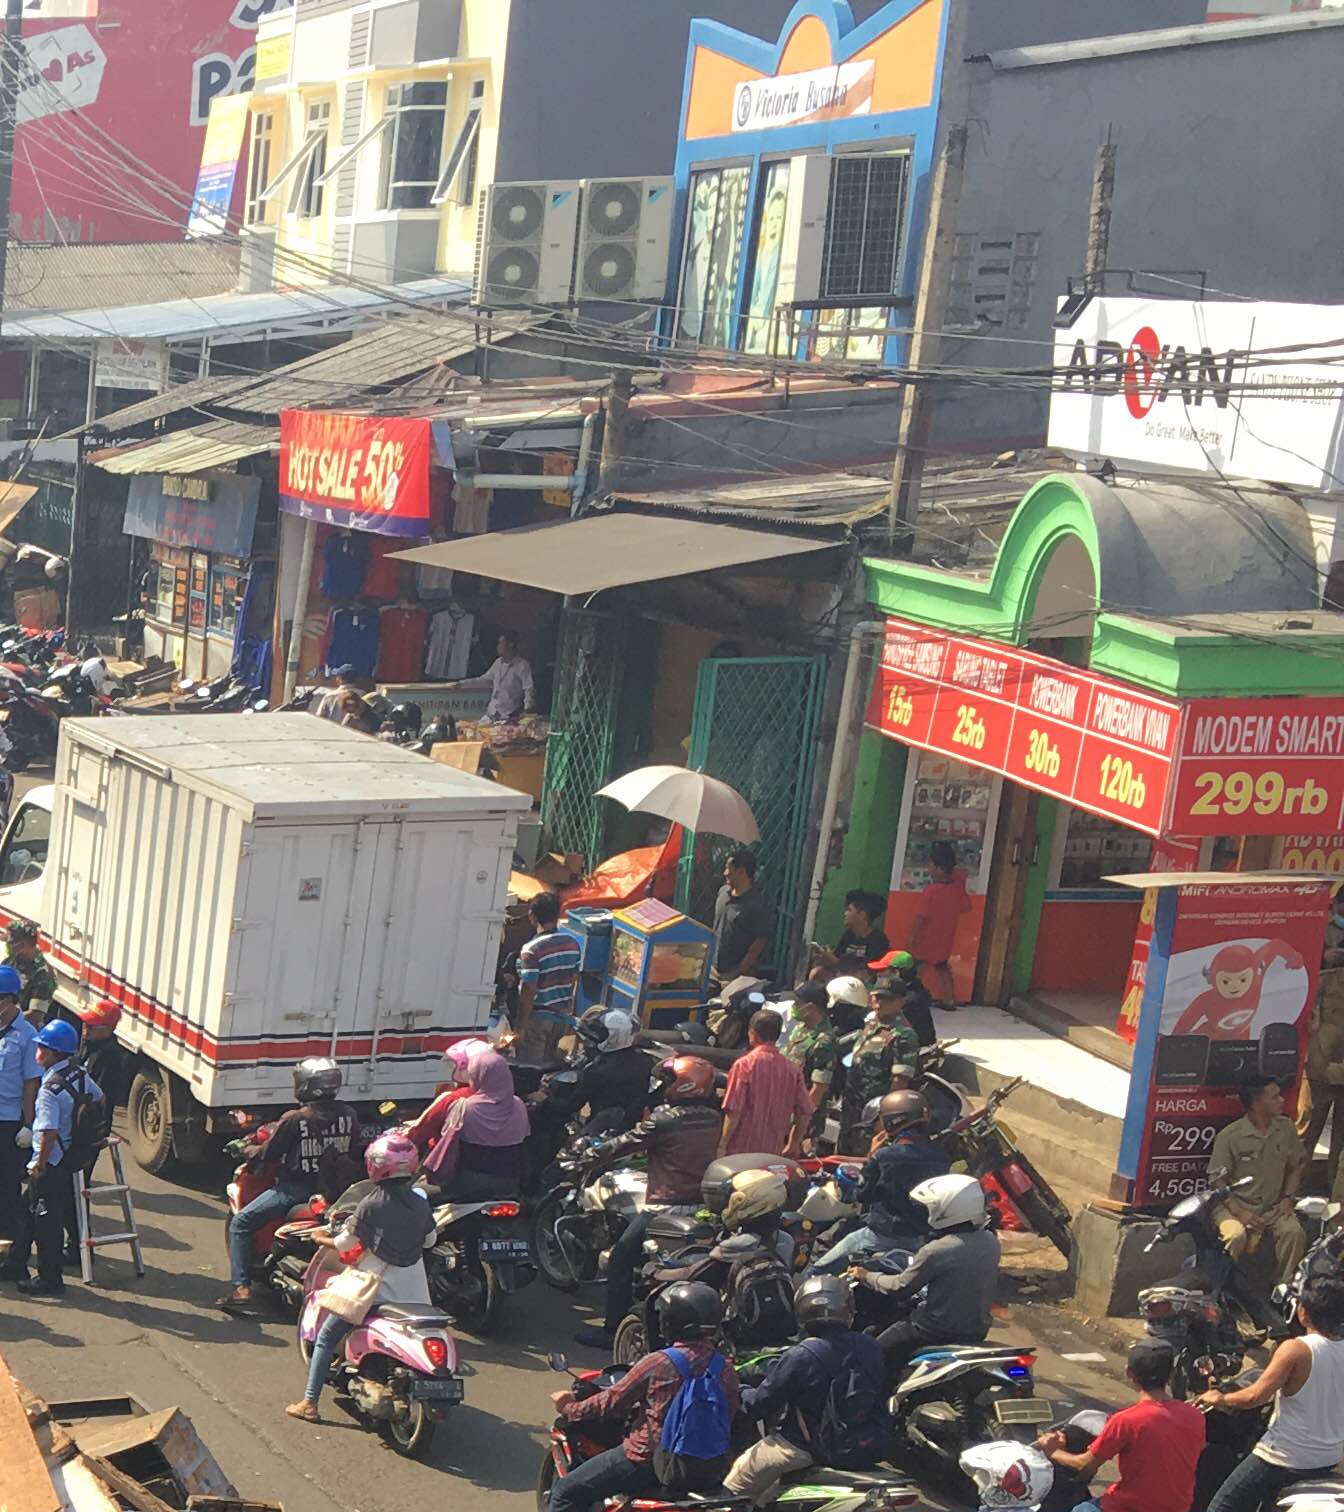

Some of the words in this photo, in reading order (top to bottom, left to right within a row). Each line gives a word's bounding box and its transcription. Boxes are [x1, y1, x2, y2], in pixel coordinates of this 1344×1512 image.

[754, 86, 799, 118] Victoria
[805, 81, 848, 112] Busana
[288, 441, 319, 492] HOT
[316, 448, 362, 500] SALE
[1028, 673, 1079, 720] POWERBANK
[1092, 693, 1146, 743] POWERBANK
[952, 704, 986, 750] 25rb
[1192, 715, 1274, 753] MODEM
[1275, 715, 1344, 753] SMART
[1025, 728, 1060, 778] 30rb
[1099, 753, 1146, 809] 120rb
[1189, 771, 1328, 815] 299rb
[1155, 1099, 1207, 1112] HARGA
[1151, 1162, 1179, 1173] FREE
